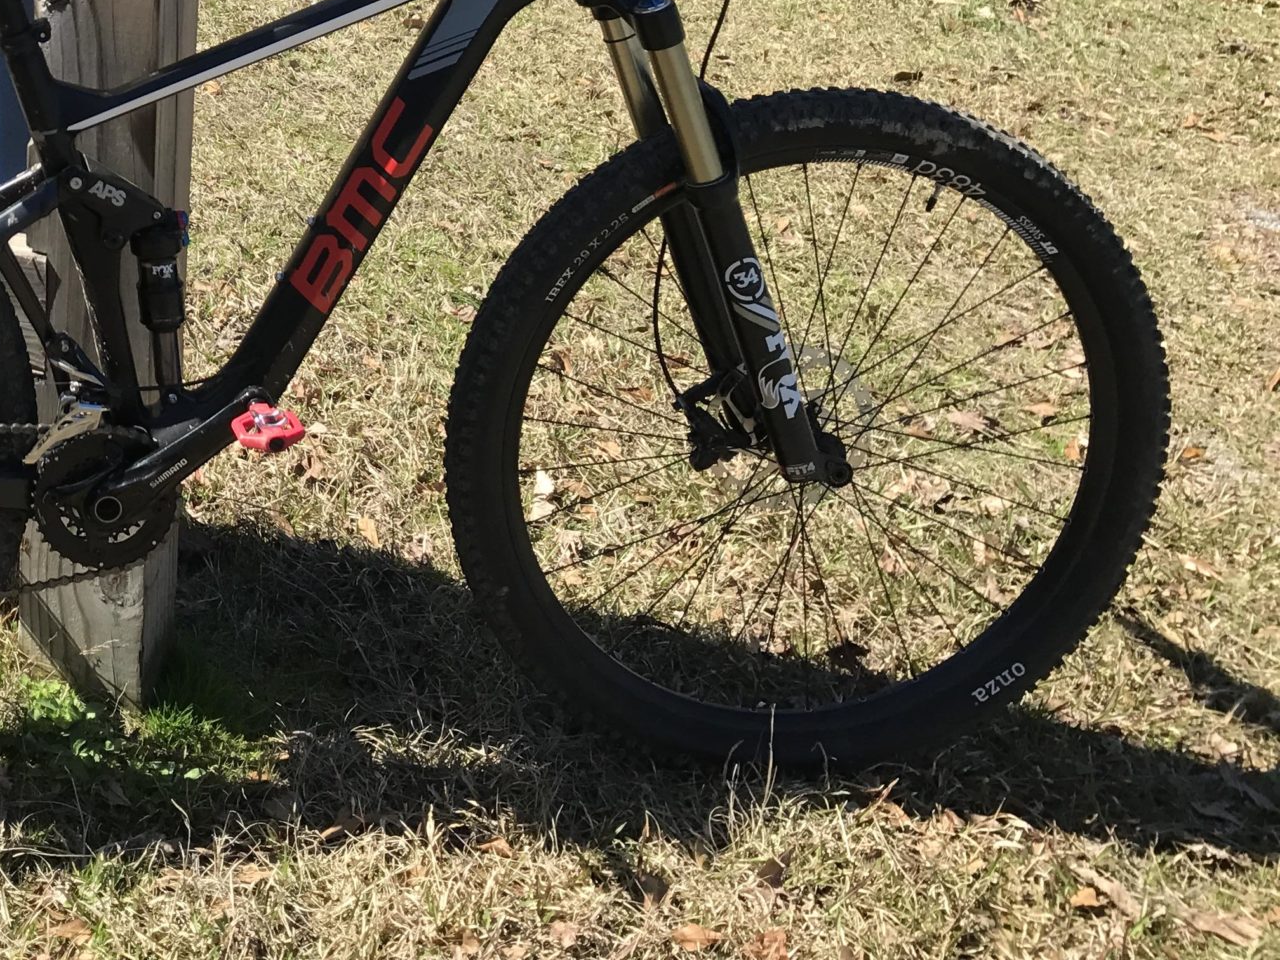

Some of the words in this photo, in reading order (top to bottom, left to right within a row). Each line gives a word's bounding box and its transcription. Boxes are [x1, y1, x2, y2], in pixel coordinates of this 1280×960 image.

[88, 180, 127, 207] APS
[912, 158, 987, 199] 483d
[290, 96, 434, 314] BMC
[1016, 214, 1045, 241] SWISS
[544, 267, 575, 303] IBEX
[572, 249, 591, 268] 29
[600, 211, 630, 240] 2.25
[1039, 239, 1059, 256] DT
[151, 263, 174, 279] FOX
[733, 266, 760, 289] 34
[149, 456, 189, 489] SHIMANO
[970, 662, 1026, 704] onza
